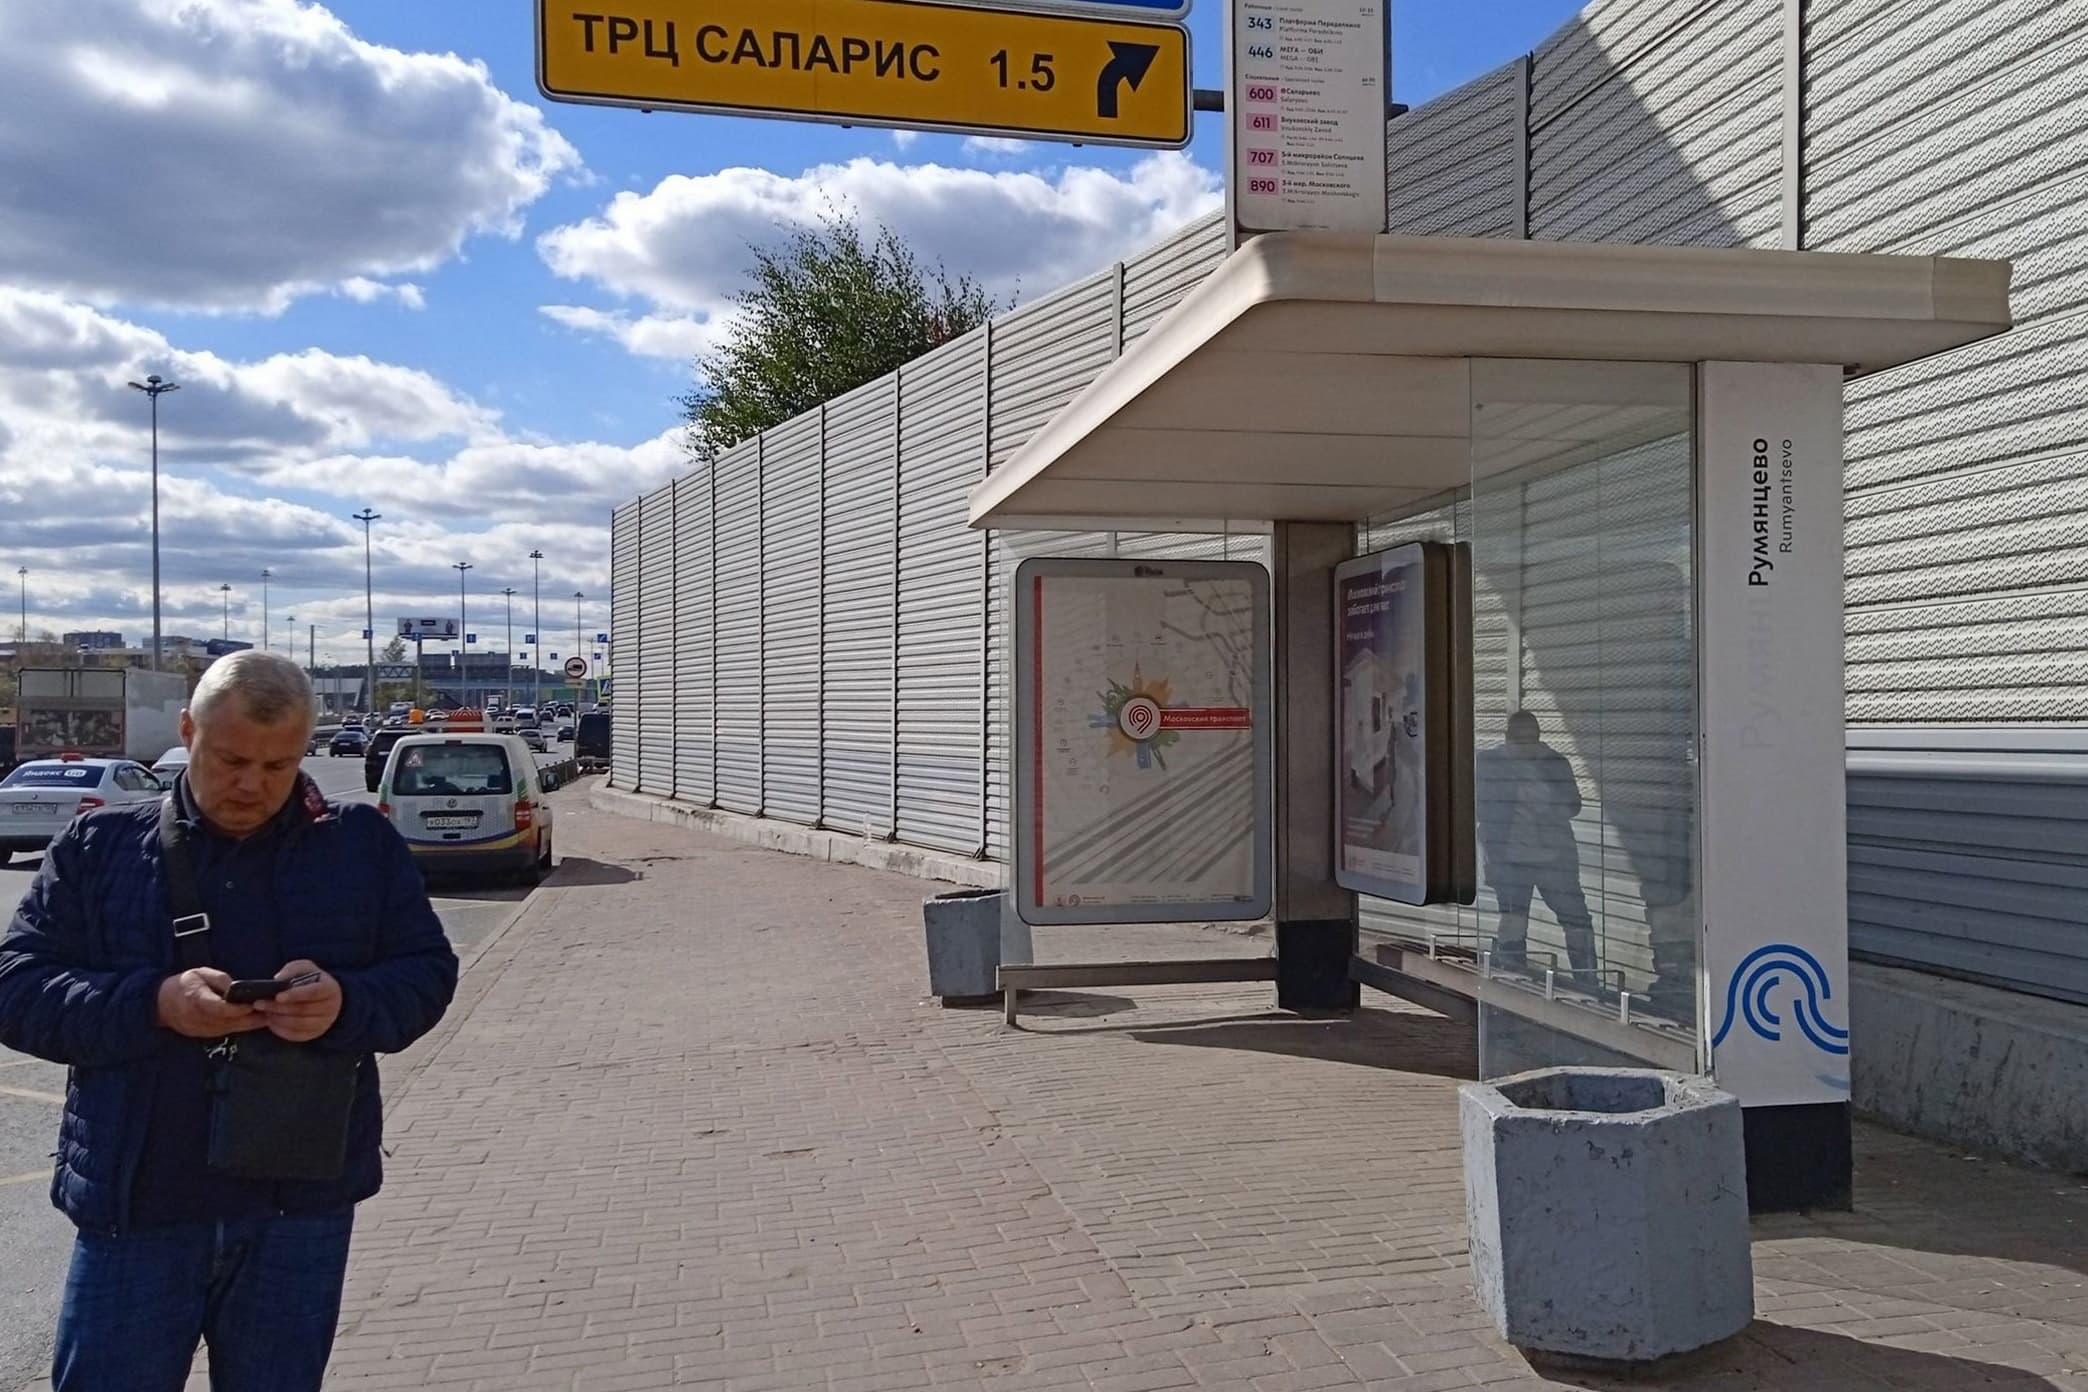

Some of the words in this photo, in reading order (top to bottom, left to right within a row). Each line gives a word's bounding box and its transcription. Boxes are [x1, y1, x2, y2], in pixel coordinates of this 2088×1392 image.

[1248, 17, 1272, 30] 343
[573, 14, 679, 67] ТРЦ
[696, 24, 940, 82] САЛАРИС
[990, 50, 1055, 92] 1.5
[1248, 46, 1273, 59] 446
[1249, 88, 1274, 100] 600
[1253, 117, 1271, 128] 611
[1251, 151, 1274, 164] 707
[1251, 180, 1275, 192] 890
[1779, 439, 1796, 553] Rumyantsevo
[1748, 438, 1774, 586] Румянцево
